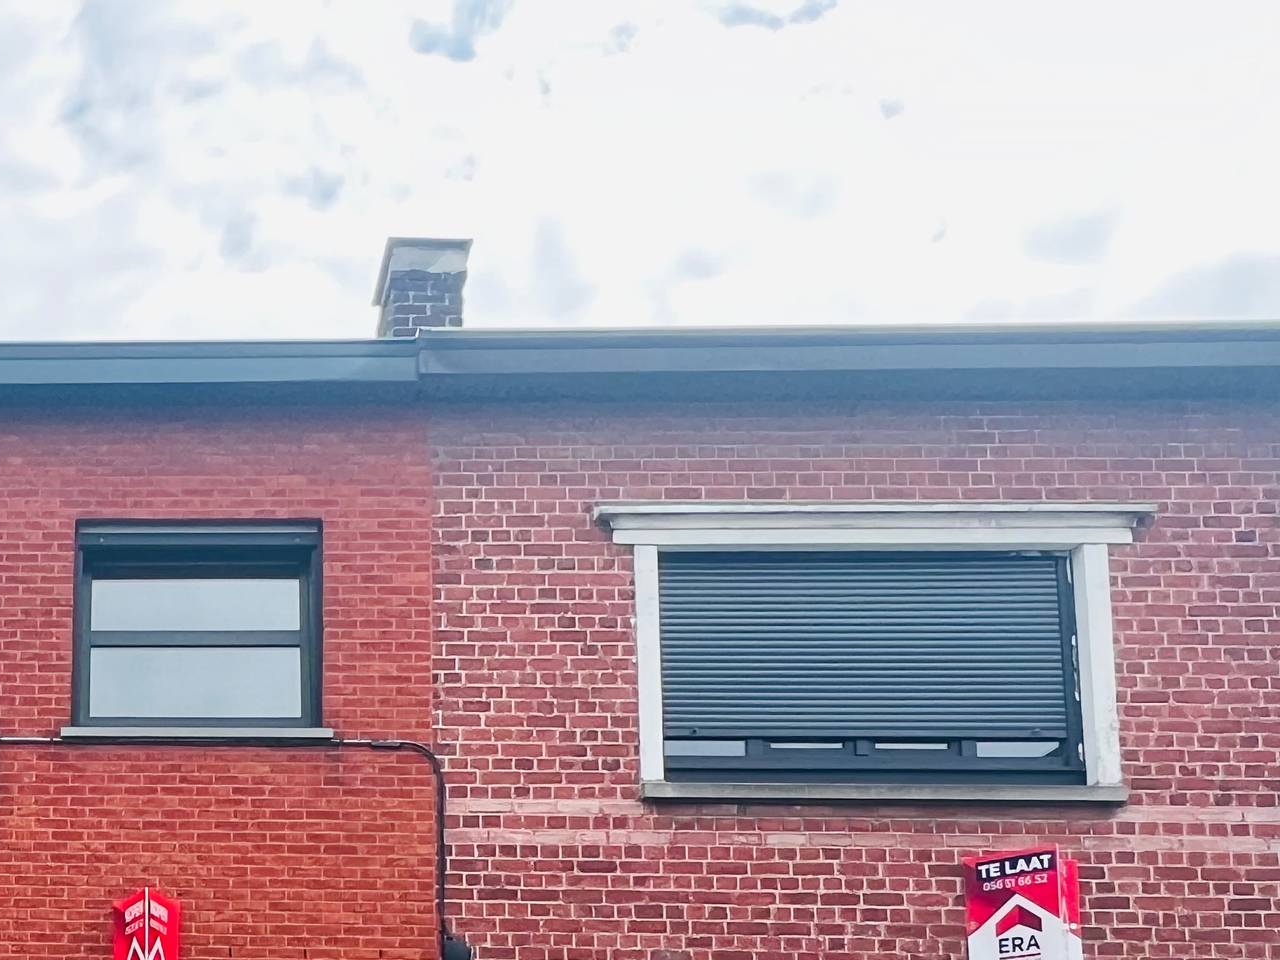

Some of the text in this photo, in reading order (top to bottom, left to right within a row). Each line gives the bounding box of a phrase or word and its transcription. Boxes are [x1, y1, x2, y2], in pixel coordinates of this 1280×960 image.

[977, 854, 1052, 878] TE LAAT
[999, 935, 1040, 954] ERA
